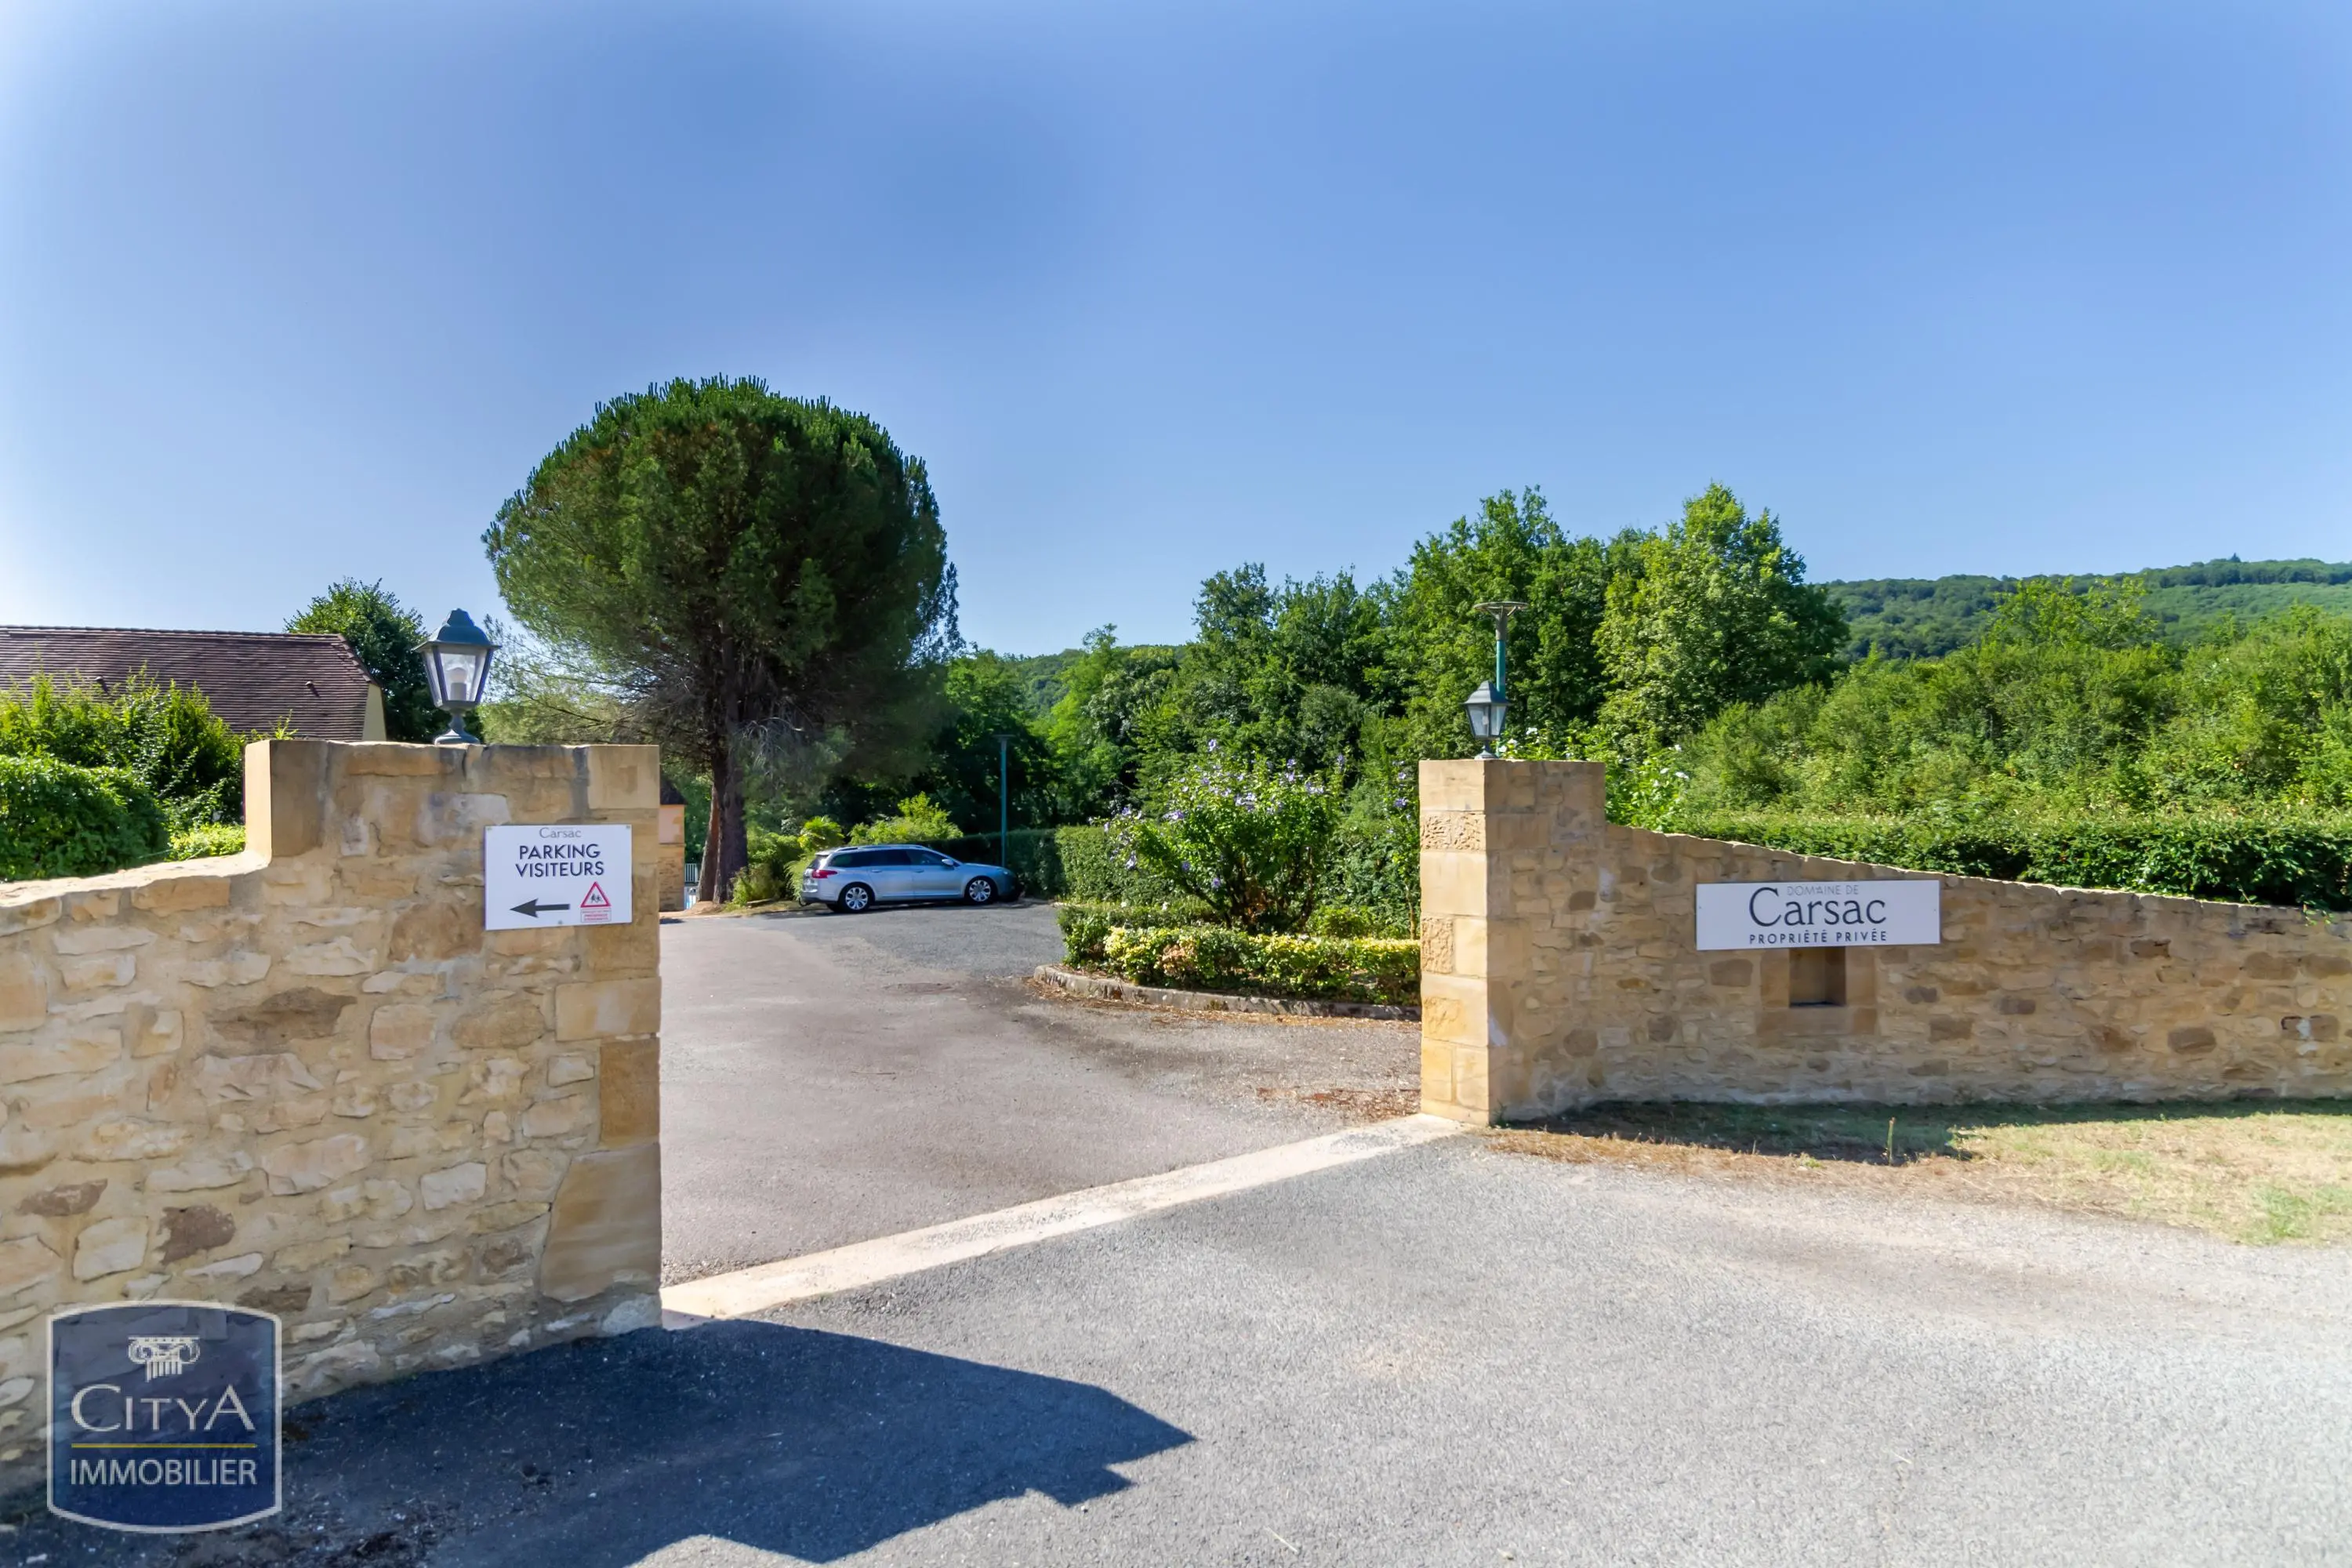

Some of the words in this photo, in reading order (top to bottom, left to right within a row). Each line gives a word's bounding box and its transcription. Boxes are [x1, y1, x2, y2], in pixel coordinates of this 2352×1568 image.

[539, 827, 582, 838] Carsac
[519, 844, 601, 860] PARKING
[515, 861, 604, 877] VISITEURS
[1787, 885, 1842, 895] DOMAINE
[1846, 884, 1859, 895] DE
[1749, 887, 1886, 927] Carsac
[1749, 930, 1828, 944] PROPRIÉTÉ
[1836, 928, 1887, 942] PRIVÉE
